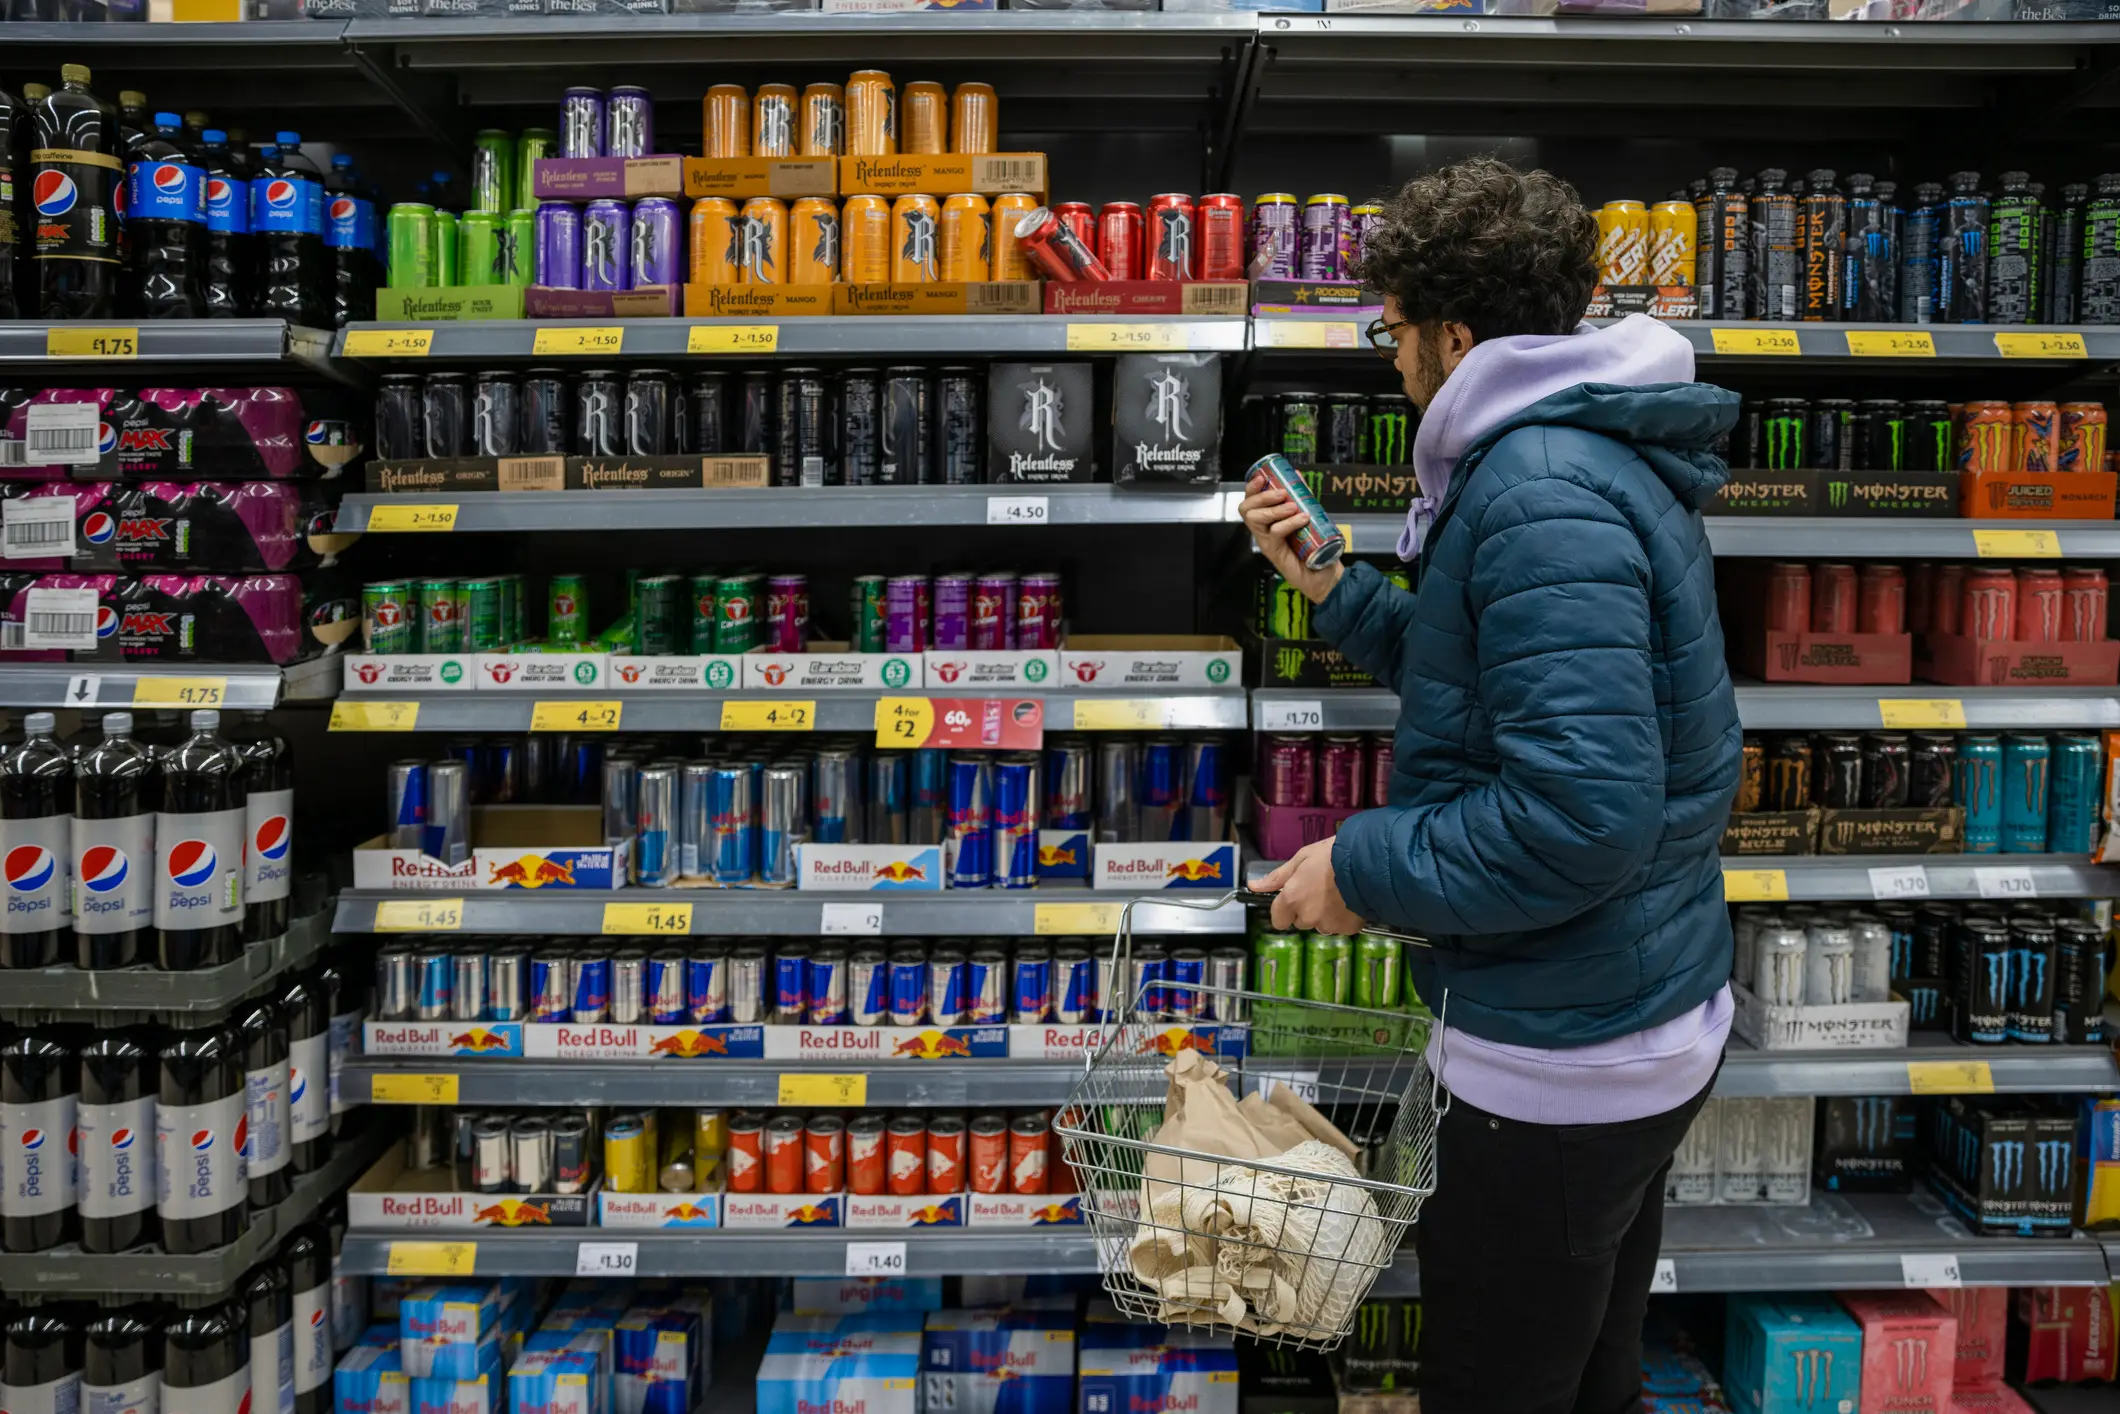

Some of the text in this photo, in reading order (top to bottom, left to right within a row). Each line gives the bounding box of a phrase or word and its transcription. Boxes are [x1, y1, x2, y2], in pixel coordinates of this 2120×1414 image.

[551, 0, 598, 12] the Best
[856, 158, 922, 187] Relentless
[1808, 211, 1825, 308] MONSTER
[709, 288, 816, 318] Relentless MANGO
[848, 286, 958, 311] Relentless MANGO
[1053, 288, 1167, 315] Relentless CHERRY
[403, 295, 461, 320] Relentless
[1646, 304, 1698, 318] ALERT
[387, 338, 394, 347] 2
[578, 335, 618, 345] 2 £1.50
[732, 333, 772, 343] 2 £1.50
[1110, 332, 1117, 341] 2
[1756, 337, 1762, 346] 2
[1891, 340, 1898, 348] 2
[93, 338, 132, 354] £1.75
[2040, 341, 2047, 350] 2
[118, 428, 175, 451] MAX
[1135, 441, 1201, 471] Relentless
[1009, 451, 1075, 480] Relentless
[380, 466, 446, 493] Relentless
[582, 461, 690, 490] Relentless ORIGIN
[1332, 473, 1417, 496] MONST
[1715, 482, 1807, 499] MONSTER
[1853, 482, 1948, 500] MONSTER
[2008, 484, 2053, 496] JUICED
[412, 514, 419, 523] 2
[1007, 507, 1044, 519] £4.50
[116, 519, 173, 541] MAX
[119, 612, 177, 635] MAX
[708, 668, 729, 681] 63
[810, 661, 861, 675] Carabao
[886, 665, 906, 680] 63
[649, 677, 699, 685] ENERGY DRINK
[801, 677, 864, 686] ENERGY DRINK
[180, 688, 219, 703] £1.75
[577, 710, 588, 722] 4
[601, 709, 616, 724] £2
[766, 710, 777, 722] 4
[791, 709, 806, 724] £2
[894, 704, 920, 717] 4 for
[944, 710, 972, 727] 60p
[1286, 711, 1320, 726] £1.70
[894, 720, 915, 738] £2
[1726, 826, 1800, 839] MONSTER
[1857, 820, 1937, 836] MONSTER
[814, 860, 870, 873] Red Bull
[1107, 859, 1163, 873] Red Bull
[1893, 877, 1925, 891] £1.70
[8, 897, 51, 914] pepsi
[84, 897, 125, 914] pepsi
[169, 894, 212, 909] pepsi
[418, 910, 457, 926] £1.45
[647, 914, 686, 930] £1.45
[866, 915, 880, 928] £2
[1808, 1018, 1893, 1032] MONSTER
[376, 1028, 439, 1042] Red Bull
[557, 1028, 637, 1046] Red Bull
[800, 1030, 880, 1049] Red Bull
[28, 1152, 42, 1197] pepsi
[117, 1152, 132, 1197] pepsi
[198, 1153, 212, 1198] pepsi
[383, 1197, 463, 1215] Red Bull
[607, 1202, 657, 1213] Red Bull
[729, 1203, 778, 1215] Red Bull
[852, 1203, 902, 1216] Red Bull
[974, 1203, 1024, 1215] Red Bull
[600, 1255, 632, 1269] £1.30
[869, 1254, 902, 1268] £1.40
[1660, 1270, 1674, 1285] £5
[1944, 1266, 1958, 1280] £5
[1006, 1351, 1036, 1366] Bull
[797, 1400, 865, 1414] Red Bull
[1130, 1395, 1199, 1412] Red Bull
